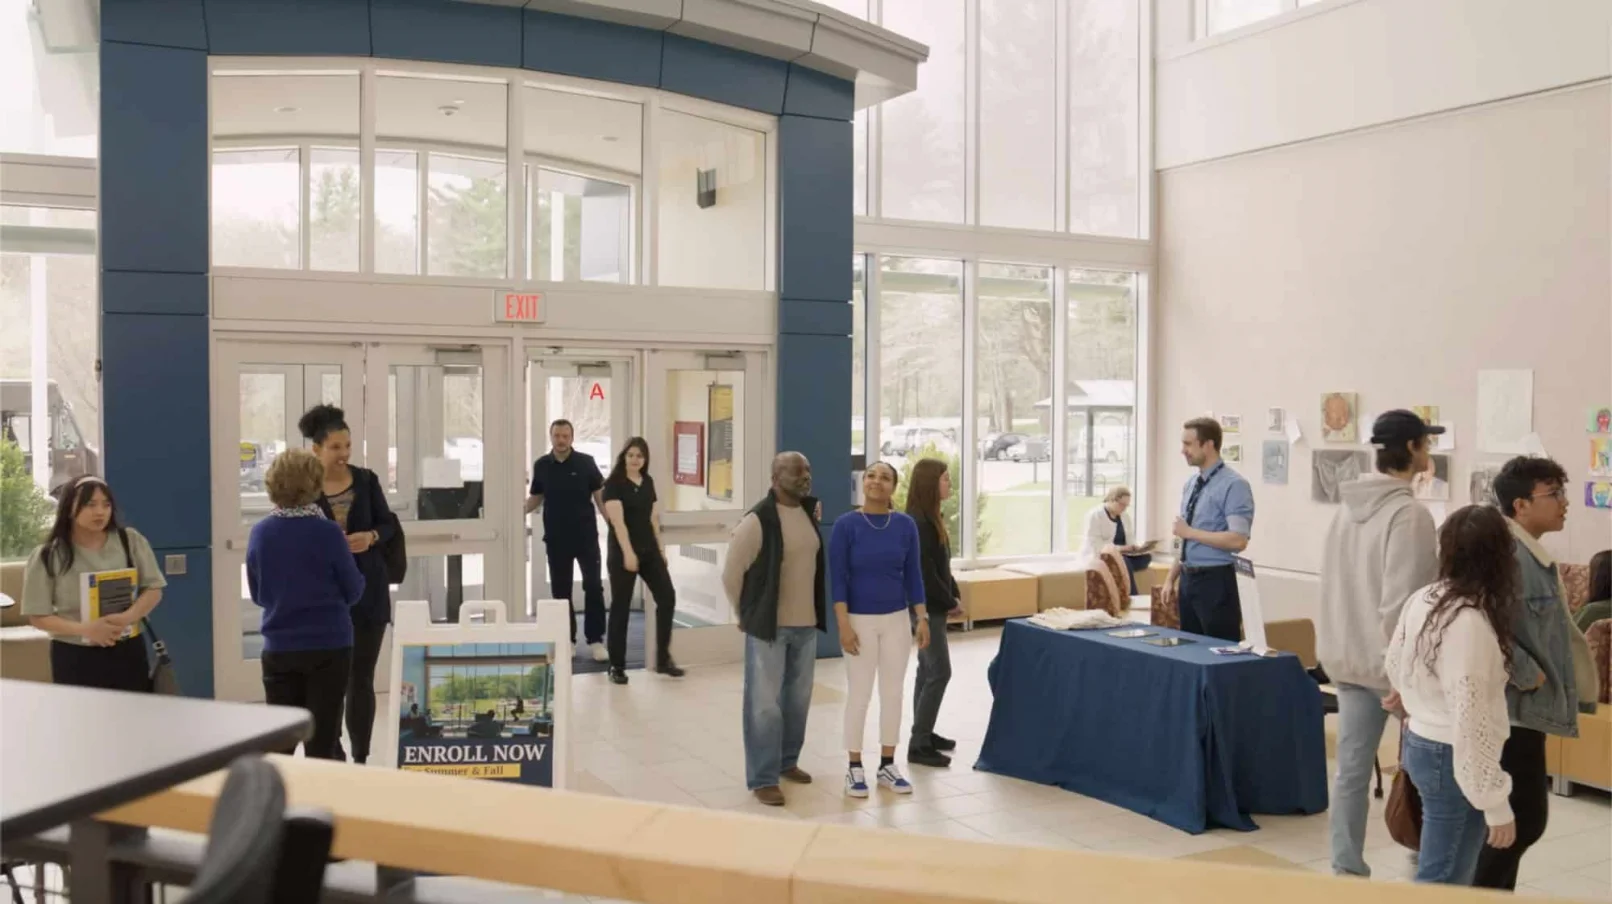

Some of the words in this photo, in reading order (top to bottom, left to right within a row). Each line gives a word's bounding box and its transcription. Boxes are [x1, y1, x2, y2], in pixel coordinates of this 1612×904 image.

[505, 294, 540, 319] EXIT
[589, 382, 604, 401] A
[403, 745, 488, 763] ENROLL
[493, 743, 546, 761] NOW
[472, 766, 480, 775] &
[484, 765, 504, 776] Fall
